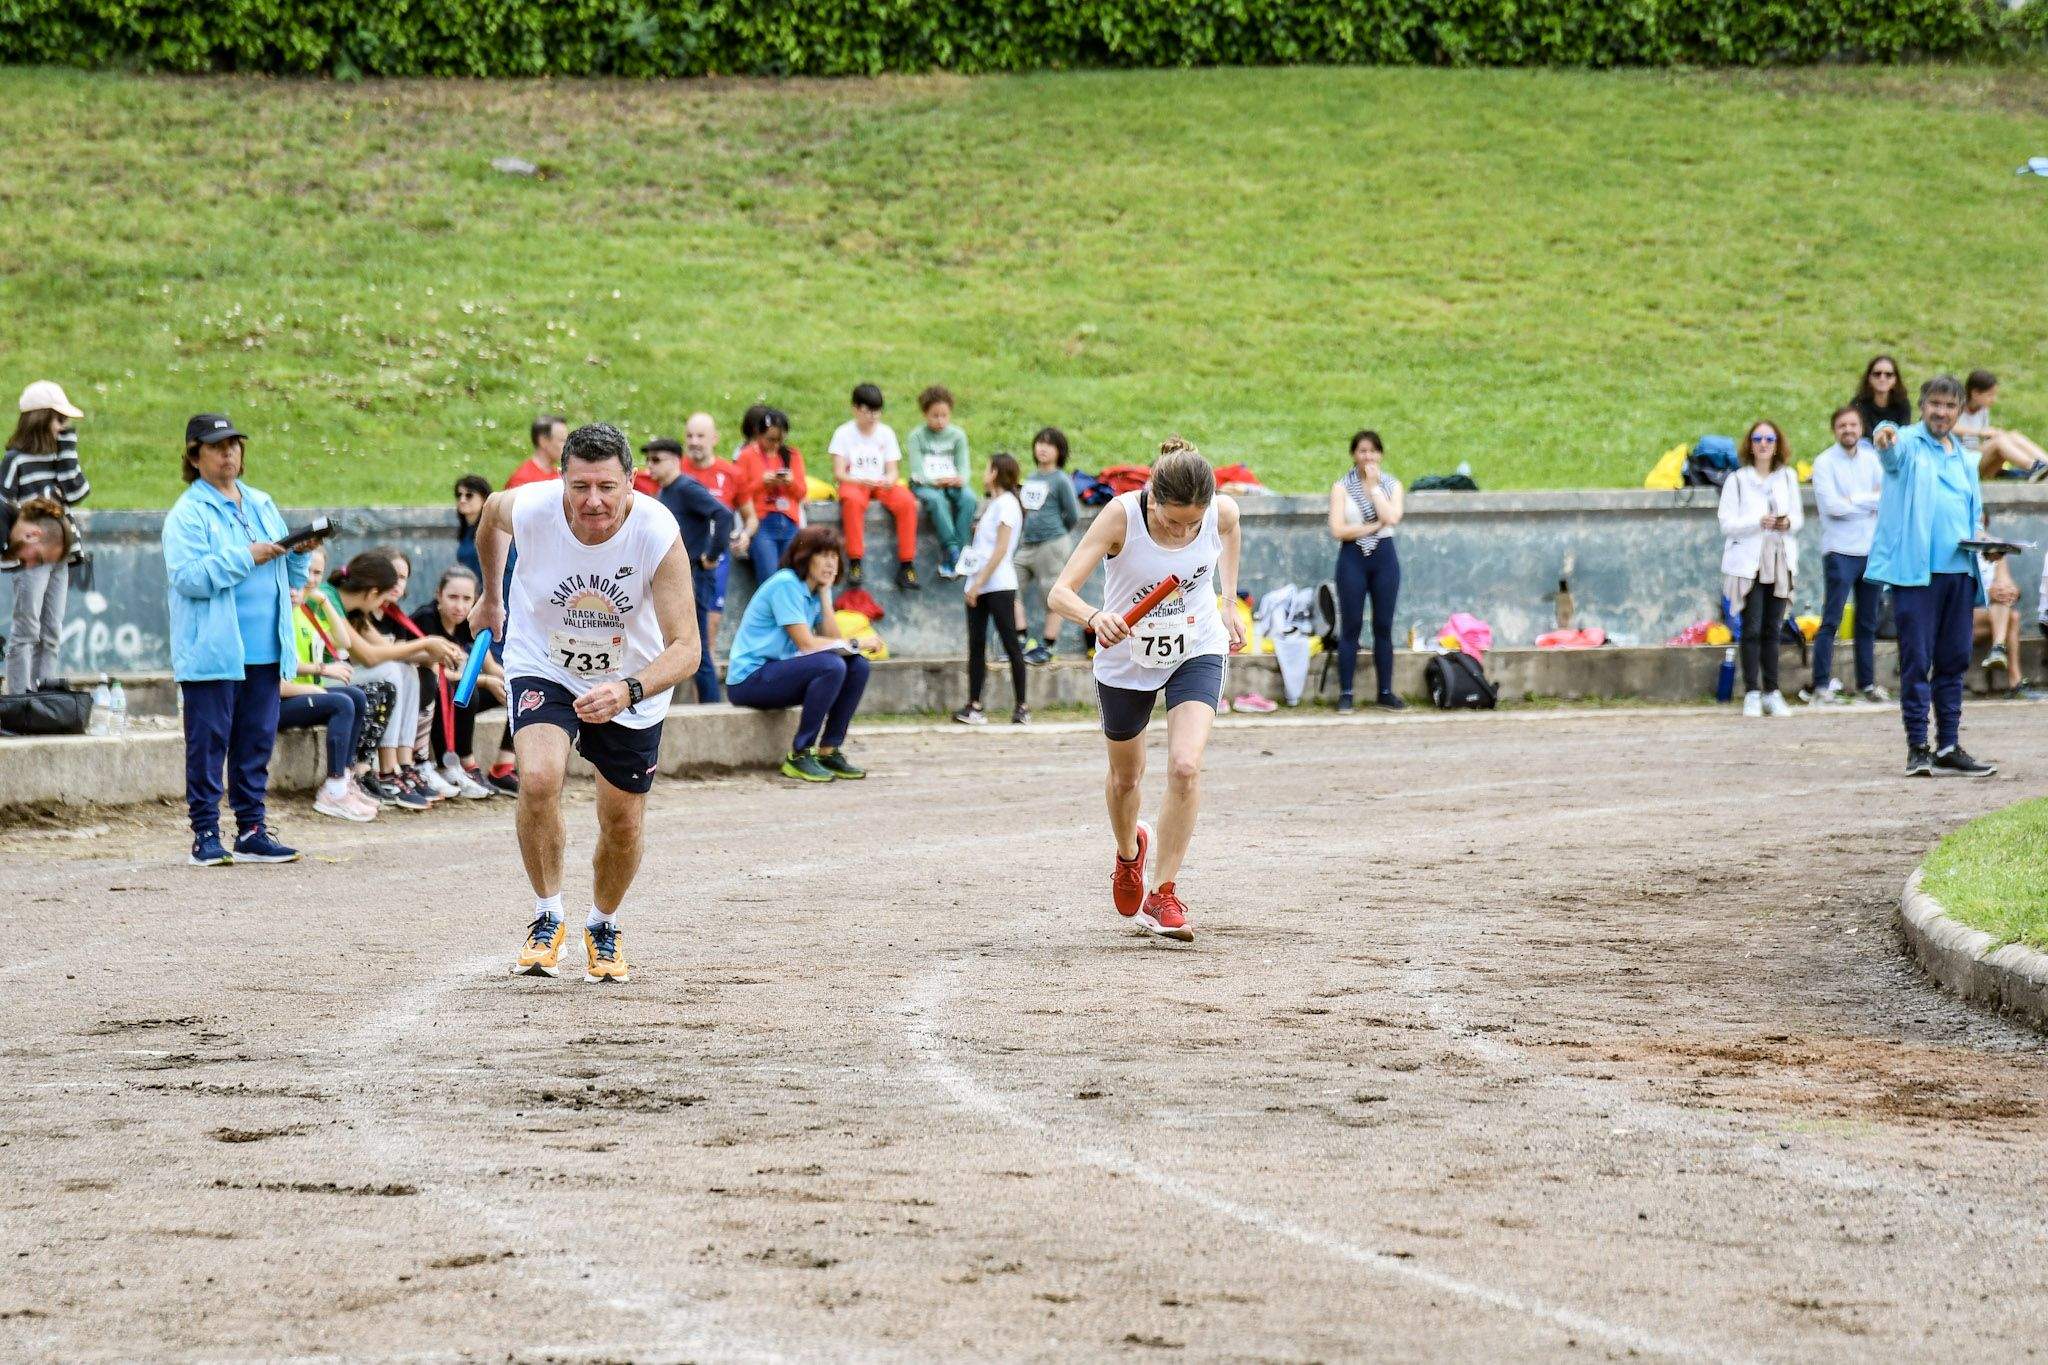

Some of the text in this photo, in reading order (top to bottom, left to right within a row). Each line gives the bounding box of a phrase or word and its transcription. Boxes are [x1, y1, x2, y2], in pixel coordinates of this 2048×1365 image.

[618, 566, 634, 575] NIKE
[550, 574, 634, 614] SANTA MONICA
[563, 617, 625, 630] VALLEHERMOSO
[566, 609, 620, 622] TRACK CLUB
[1141, 634, 1184, 657] 751
[560, 649, 610, 672] 733
